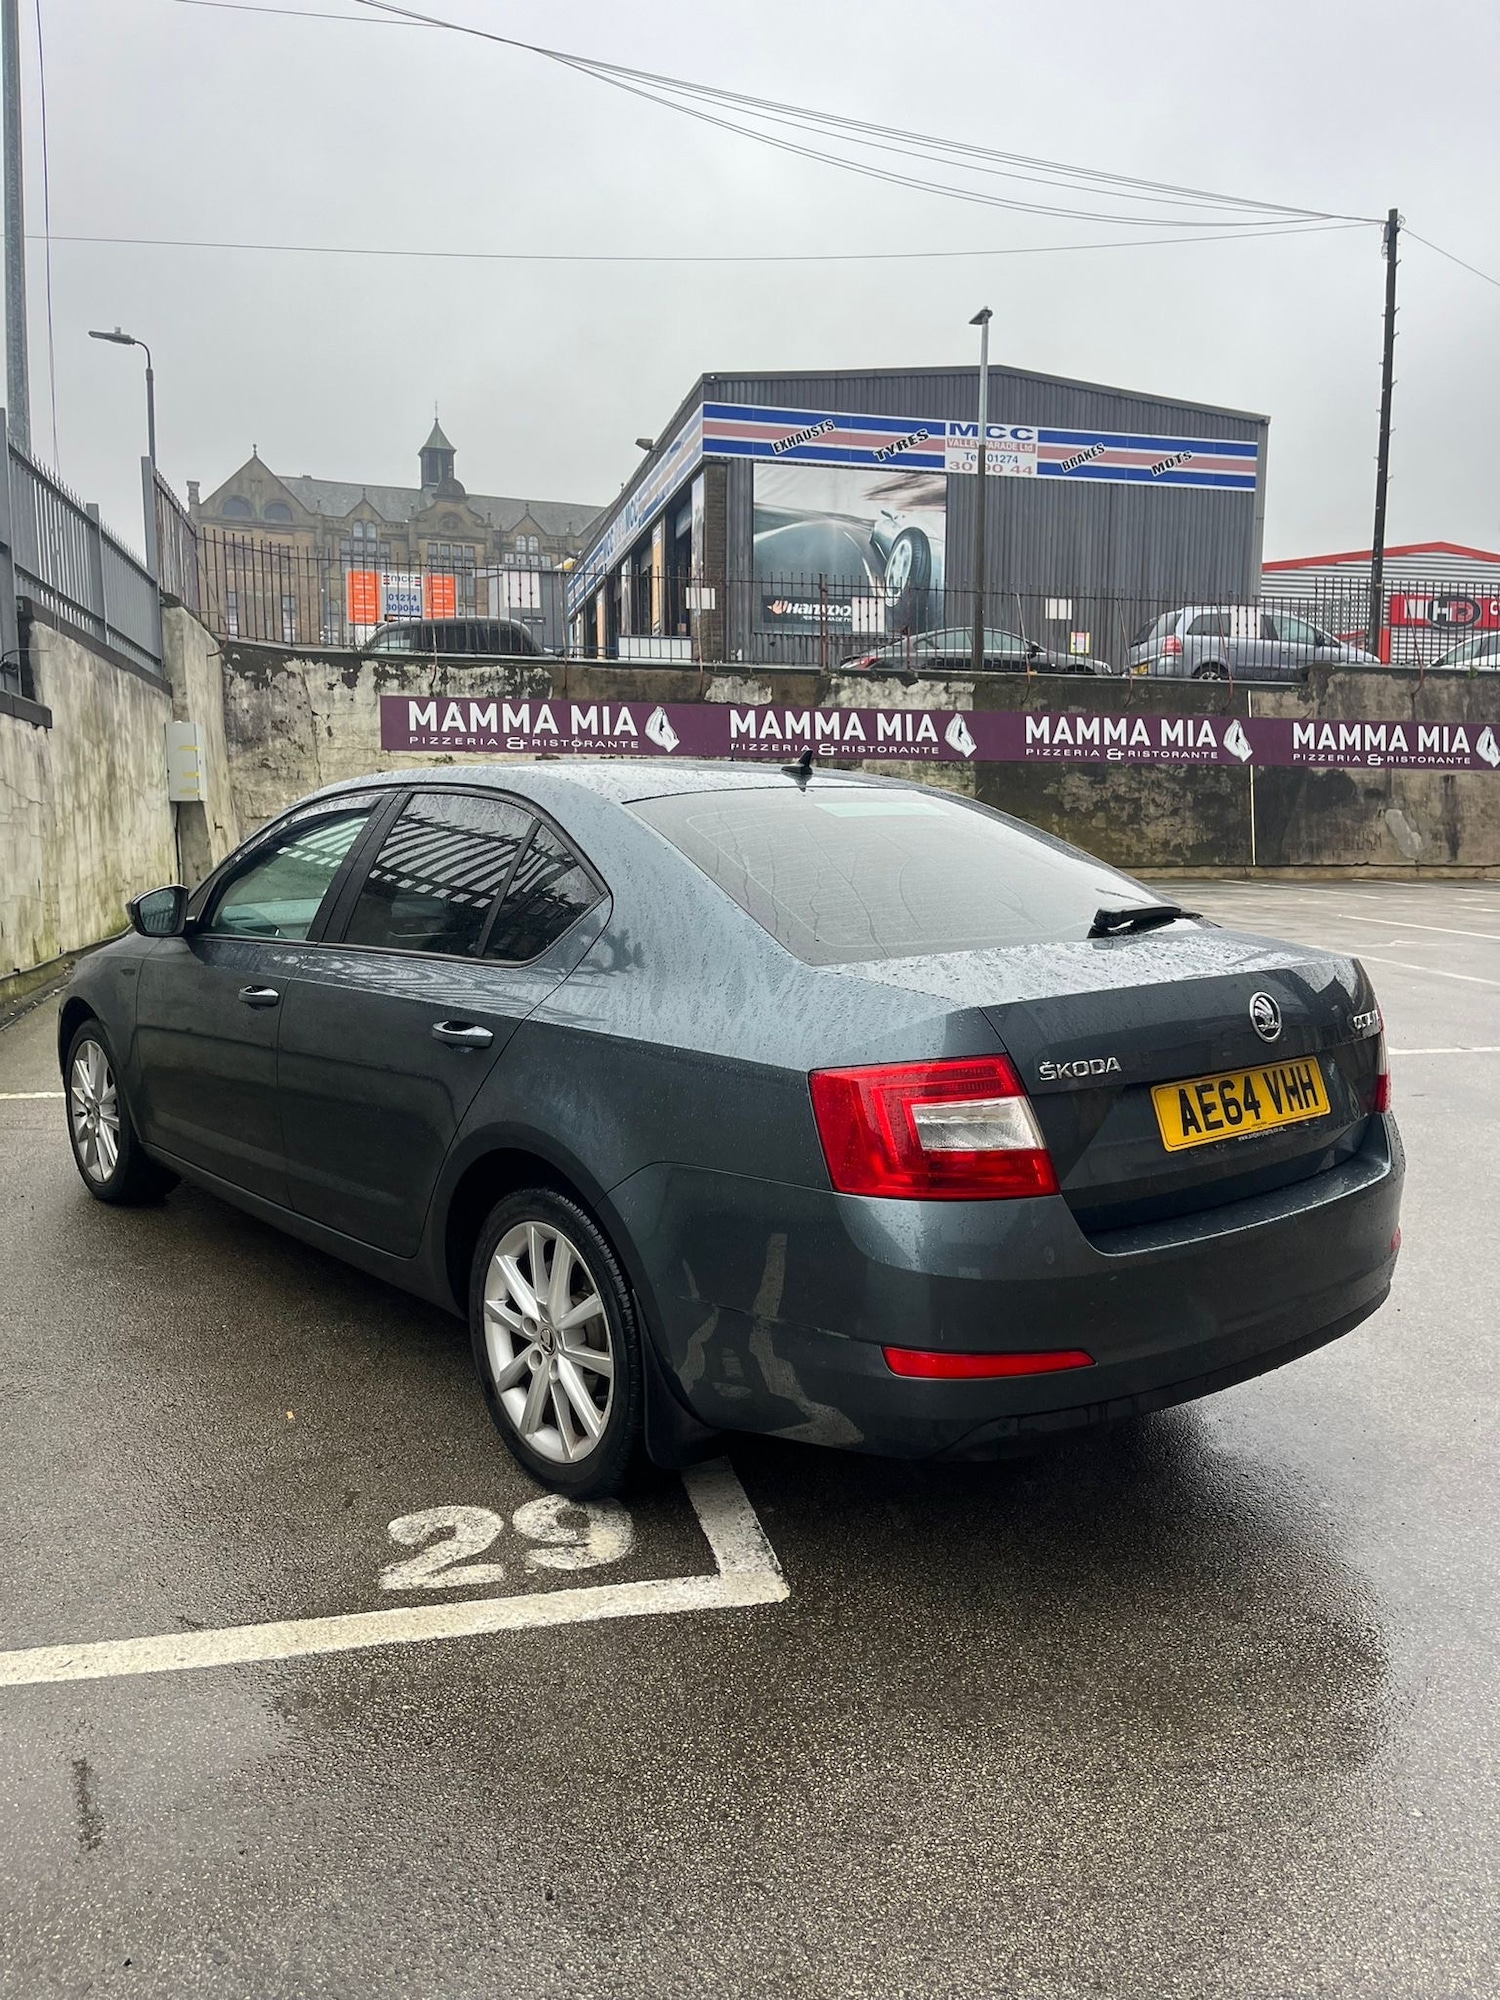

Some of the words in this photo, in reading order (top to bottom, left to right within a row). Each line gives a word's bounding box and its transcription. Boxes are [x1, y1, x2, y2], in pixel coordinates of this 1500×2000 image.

[773, 420, 835, 453] EXHAUSTS
[949, 423, 1034, 441] MCC
[874, 429, 930, 461] TYRES
[1020, 443, 1033, 452] Ltd
[949, 461, 973, 472] 30
[1010, 465, 1033, 475] 44
[964, 452, 977, 462] Te
[987, 453, 1018, 464] 01274
[1062, 444, 1105, 472] BRAKES
[388, 593, 418, 602] 01274
[408, 701, 560, 735] MAMMA
[570, 704, 639, 737] MIA
[729, 709, 867, 742] MAMMA
[876, 713, 939, 743] MIA
[409, 736, 498, 747] PIZZERIA
[506, 736, 527, 750] &
[532, 738, 639, 749] RISTORANTE
[1025, 715, 1151, 746] MAMMA
[1160, 718, 1218, 748] MIA
[1292, 722, 1409, 752] MAMMA
[1417, 725, 1471, 754] MIA
[731, 742, 811, 752] PIZZERIA
[818, 743, 837, 756] &
[842, 744, 939, 755] RISTORANTE
[1026, 748, 1100, 757] PIZZERIA
[1107, 748, 1125, 761] &
[1128, 750, 1218, 759] RISTORANTE
[1293, 753, 1362, 763] PIZZERIA
[1366, 753, 1385, 766] &
[1387, 755, 1471, 765] RISTORANTE
[1039, 1057, 1122, 1081] ŠKODA
[1178, 1075, 1262, 1137] AE64
[1261, 1064, 1320, 1115] VHH
[378, 1494, 637, 1590] 29
